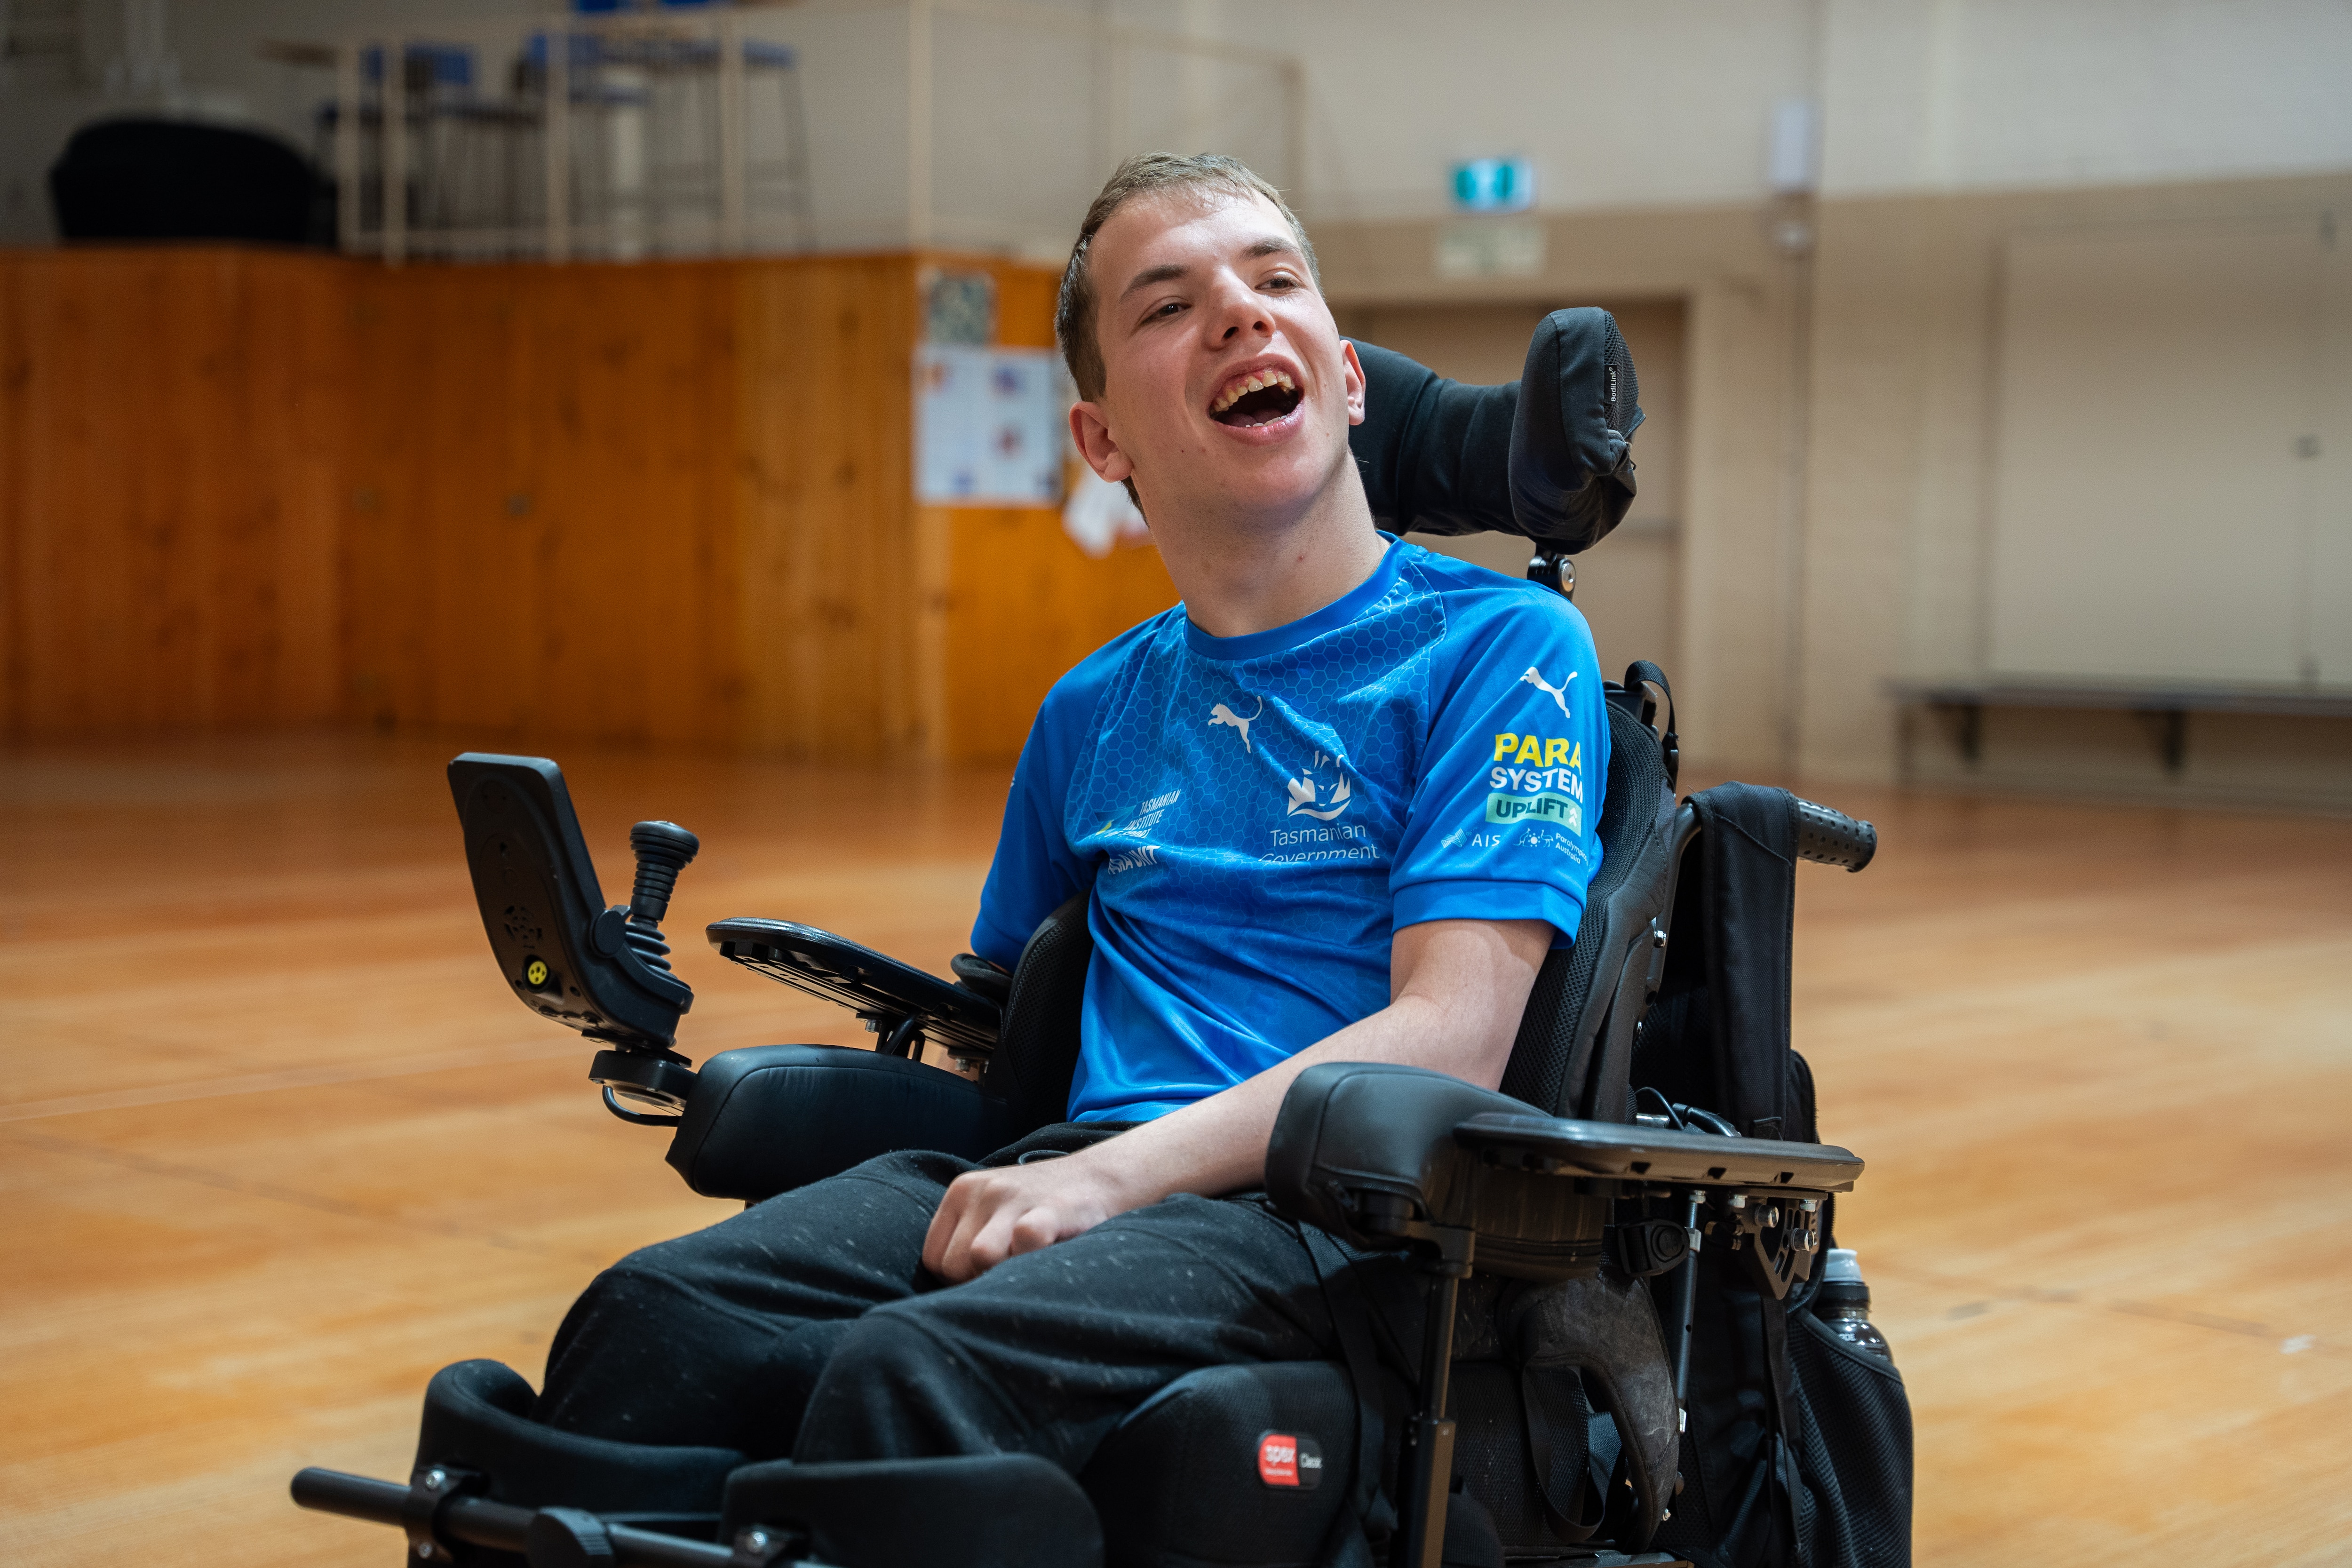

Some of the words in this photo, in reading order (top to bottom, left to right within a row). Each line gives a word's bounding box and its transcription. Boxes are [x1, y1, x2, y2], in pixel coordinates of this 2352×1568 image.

[1494, 732, 1581, 776] PARA
[1490, 766, 1583, 804] SYSTEM
[1139, 789, 1181, 816] TASMANIAN
[1496, 798, 1568, 818] UPLIFT
[1122, 809, 1165, 830] INSTITUTE
[1270, 823, 1366, 847] Tasmanian
[1471, 834, 1501, 847] AIS
[1125, 845, 1161, 868] UNIT
[1258, 844, 1380, 862] Government
[1555, 842, 1581, 864] Australia
